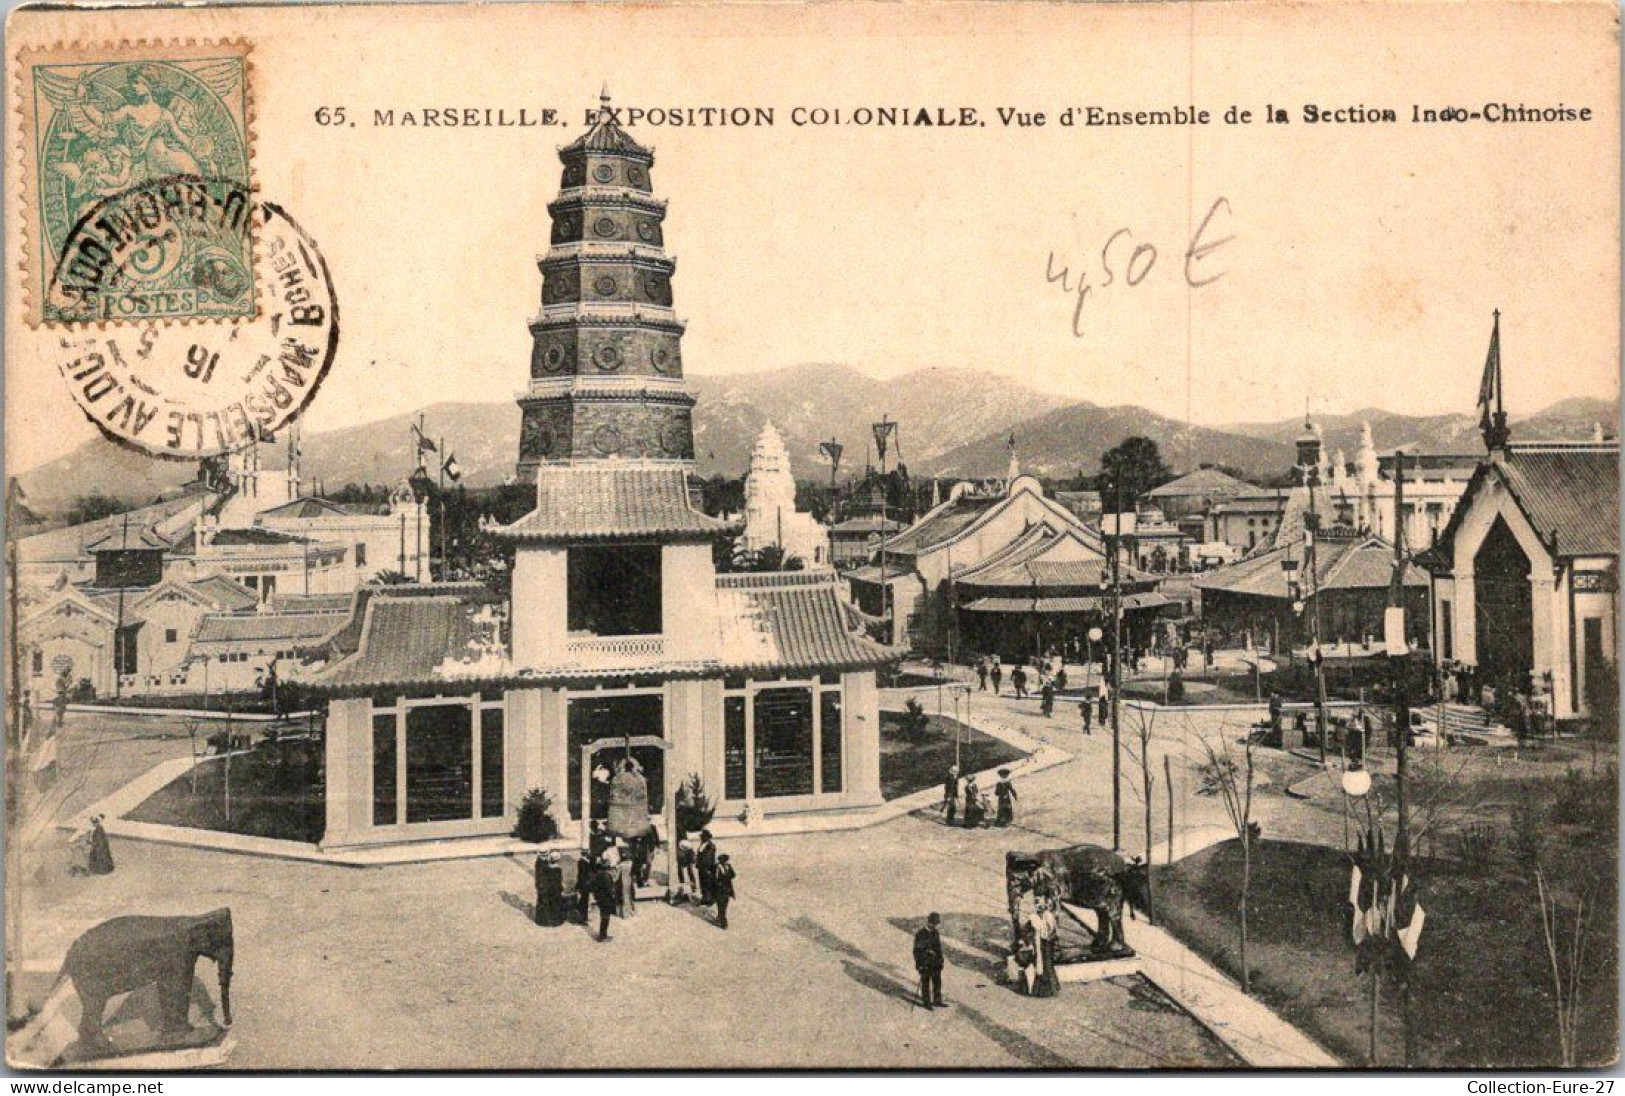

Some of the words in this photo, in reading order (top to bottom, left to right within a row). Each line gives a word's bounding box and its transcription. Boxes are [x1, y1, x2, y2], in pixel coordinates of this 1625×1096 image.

[314, 106, 356, 127] 65.
[373, 108, 568, 127] MARSEILLE.
[583, 107, 774, 126] EXPOSITION
[790, 107, 984, 127] COLONIALE.
[996, 107, 1046, 127] Vue
[1059, 105, 1210, 127] d'Ensemble
[1224, 105, 1252, 125] de
[1266, 104, 1289, 125] la
[1302, 103, 1397, 124] Section
[1411, 102, 1592, 123] Indo-Chinoise
[103, 291, 194, 315] POSTES
